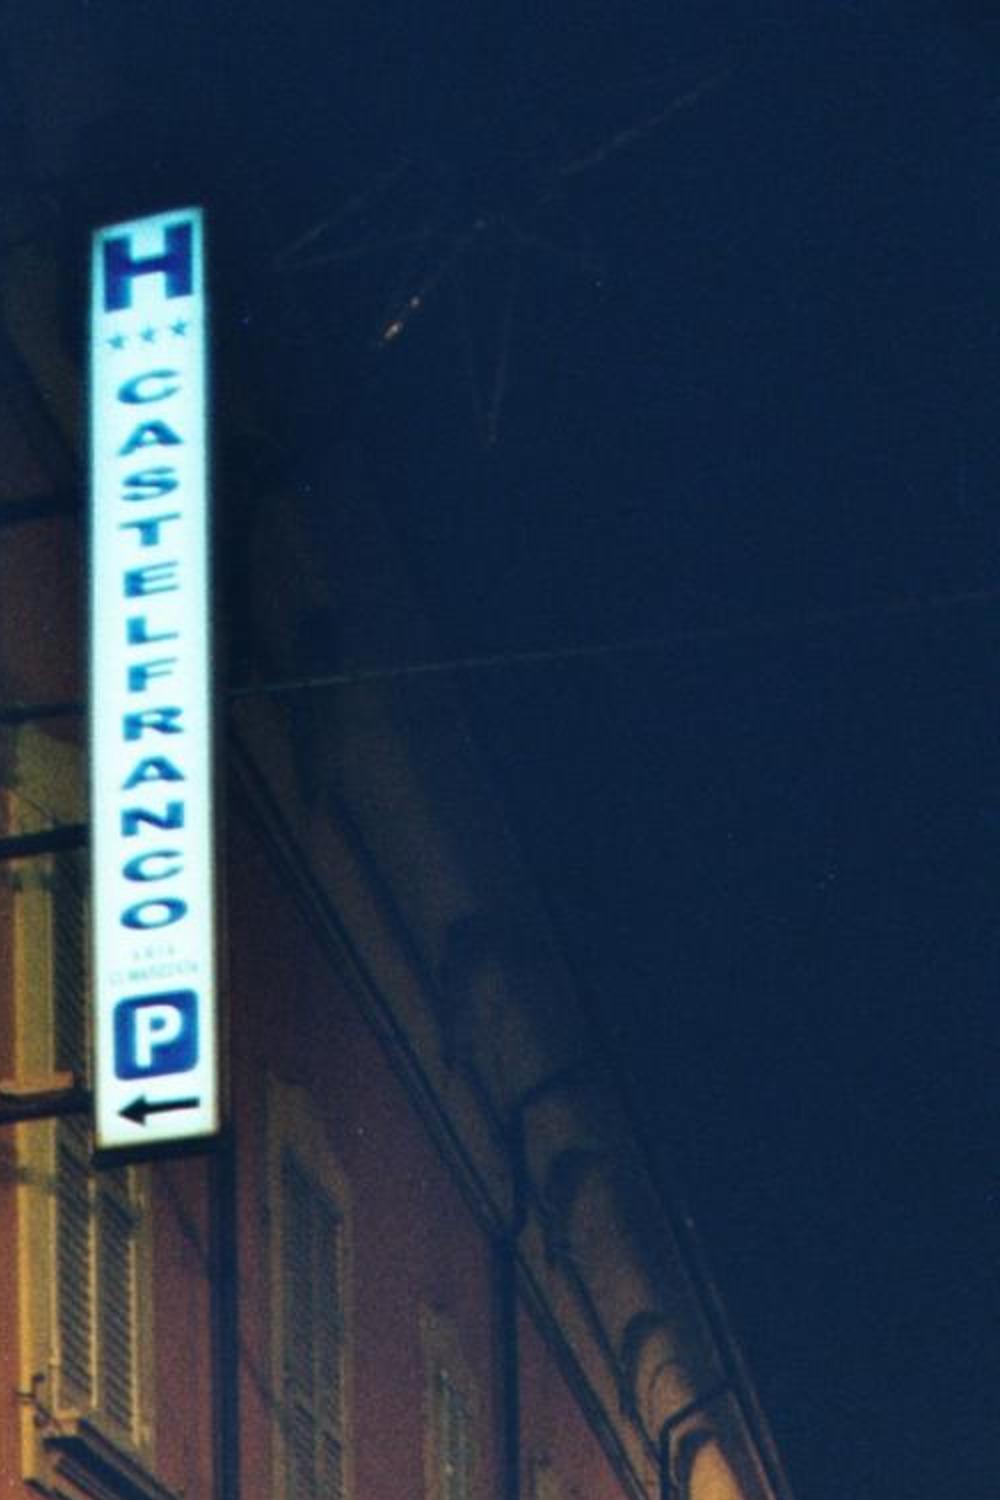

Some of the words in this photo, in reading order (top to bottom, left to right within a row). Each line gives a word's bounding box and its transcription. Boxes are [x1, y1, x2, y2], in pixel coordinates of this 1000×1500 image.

[103, 221, 193, 313] H
[117, 368, 188, 931] CASTELFRANCO
[134, 1003, 183, 1068] P
